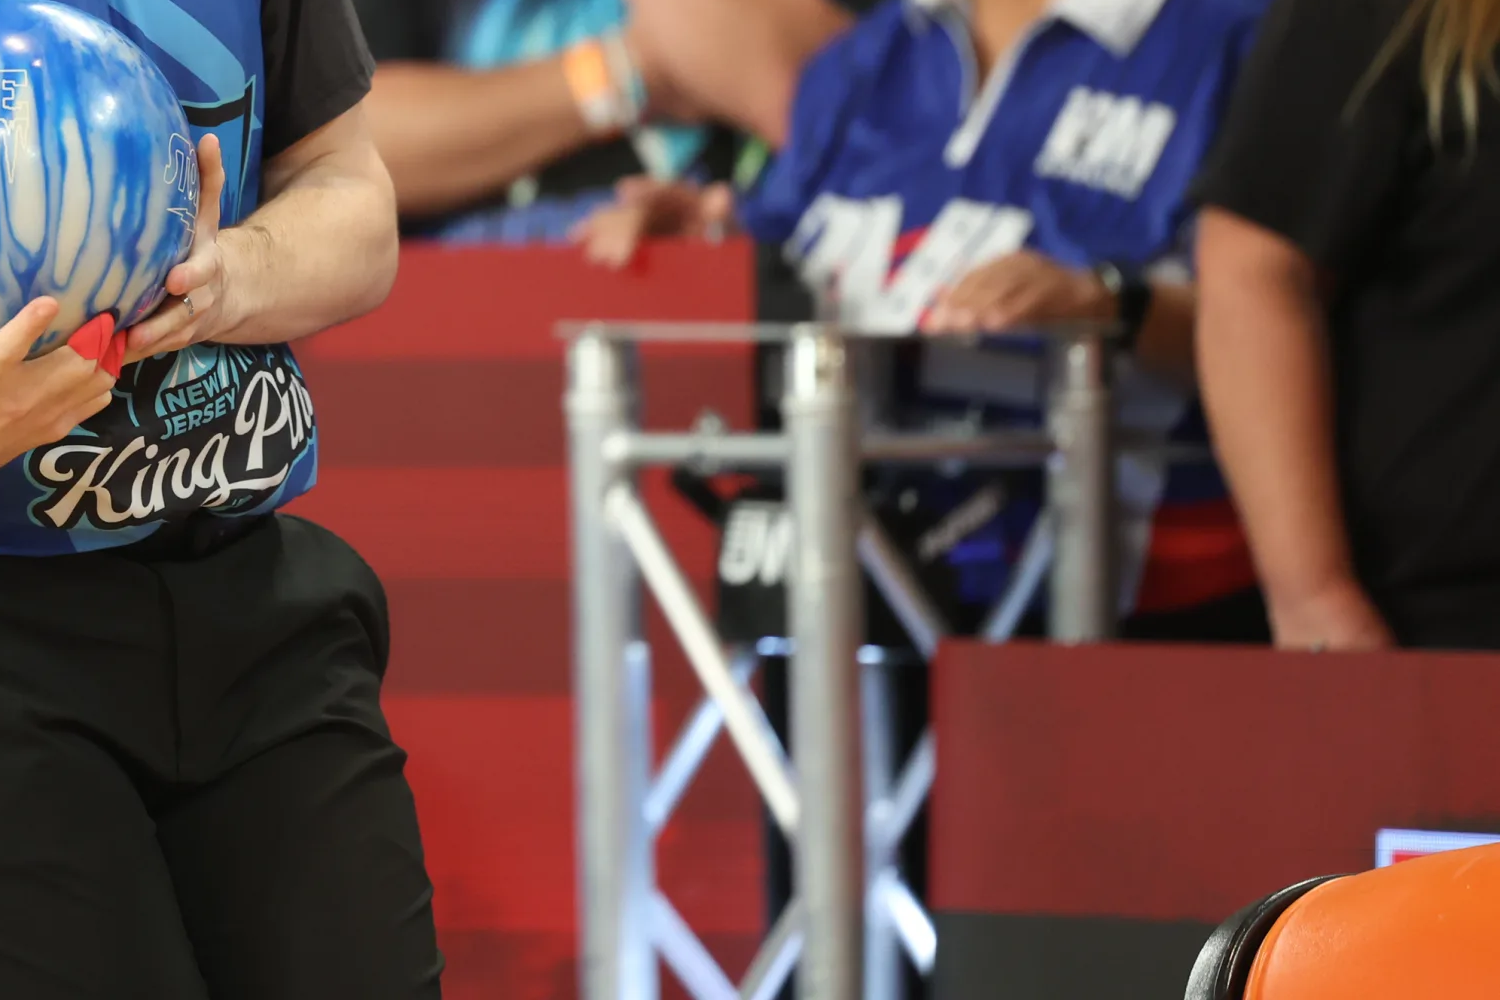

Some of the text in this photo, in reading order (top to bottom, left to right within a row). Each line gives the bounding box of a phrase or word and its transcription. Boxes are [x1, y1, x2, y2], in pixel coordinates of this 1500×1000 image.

[160, 387, 236, 440] JERSEY
[165, 373, 221, 413] NEW
[39, 432, 288, 527] King
